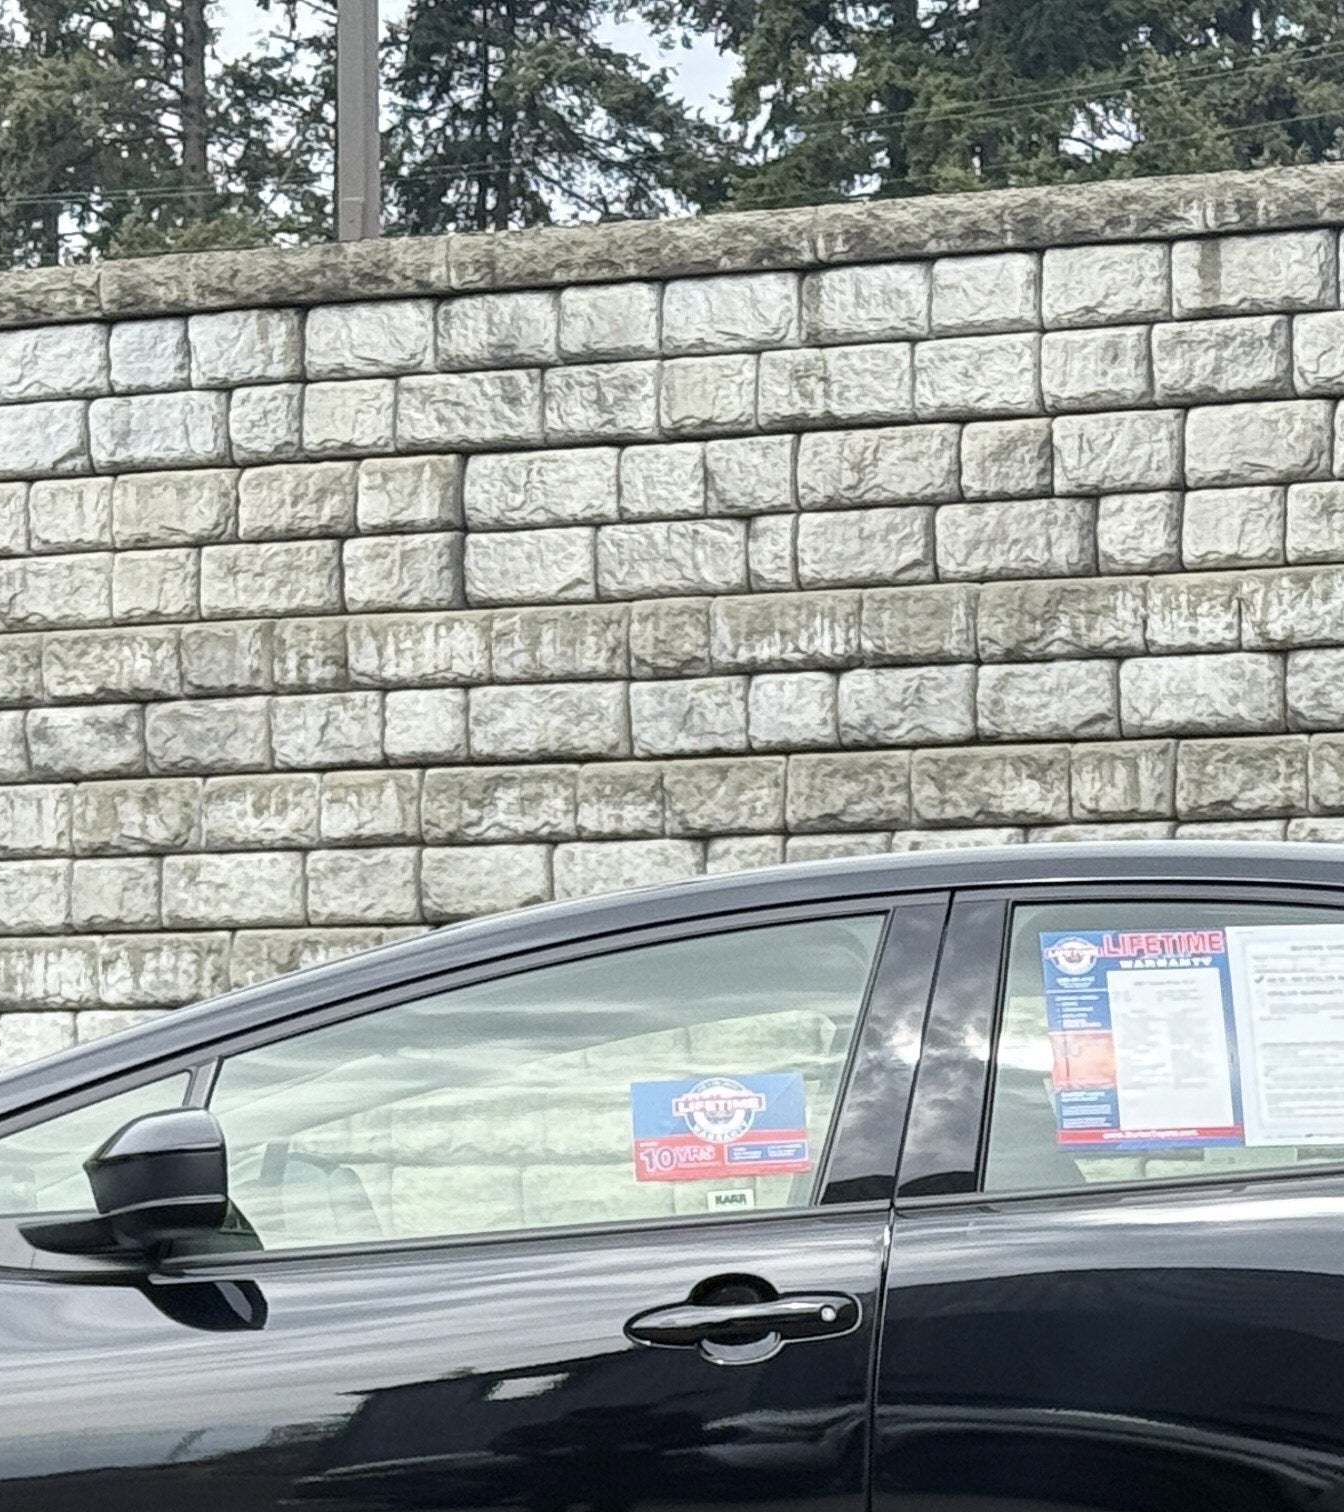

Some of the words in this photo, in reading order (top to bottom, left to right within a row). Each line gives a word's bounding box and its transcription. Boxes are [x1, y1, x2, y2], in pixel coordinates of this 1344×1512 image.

[1103, 931, 1225, 957] LIFETIME
[1119, 957, 1212, 969] WARRANTY
[678, 1098, 760, 1113] LIFETIME
[640, 1146, 676, 1172] 10
[677, 1145, 715, 1163] YRS
